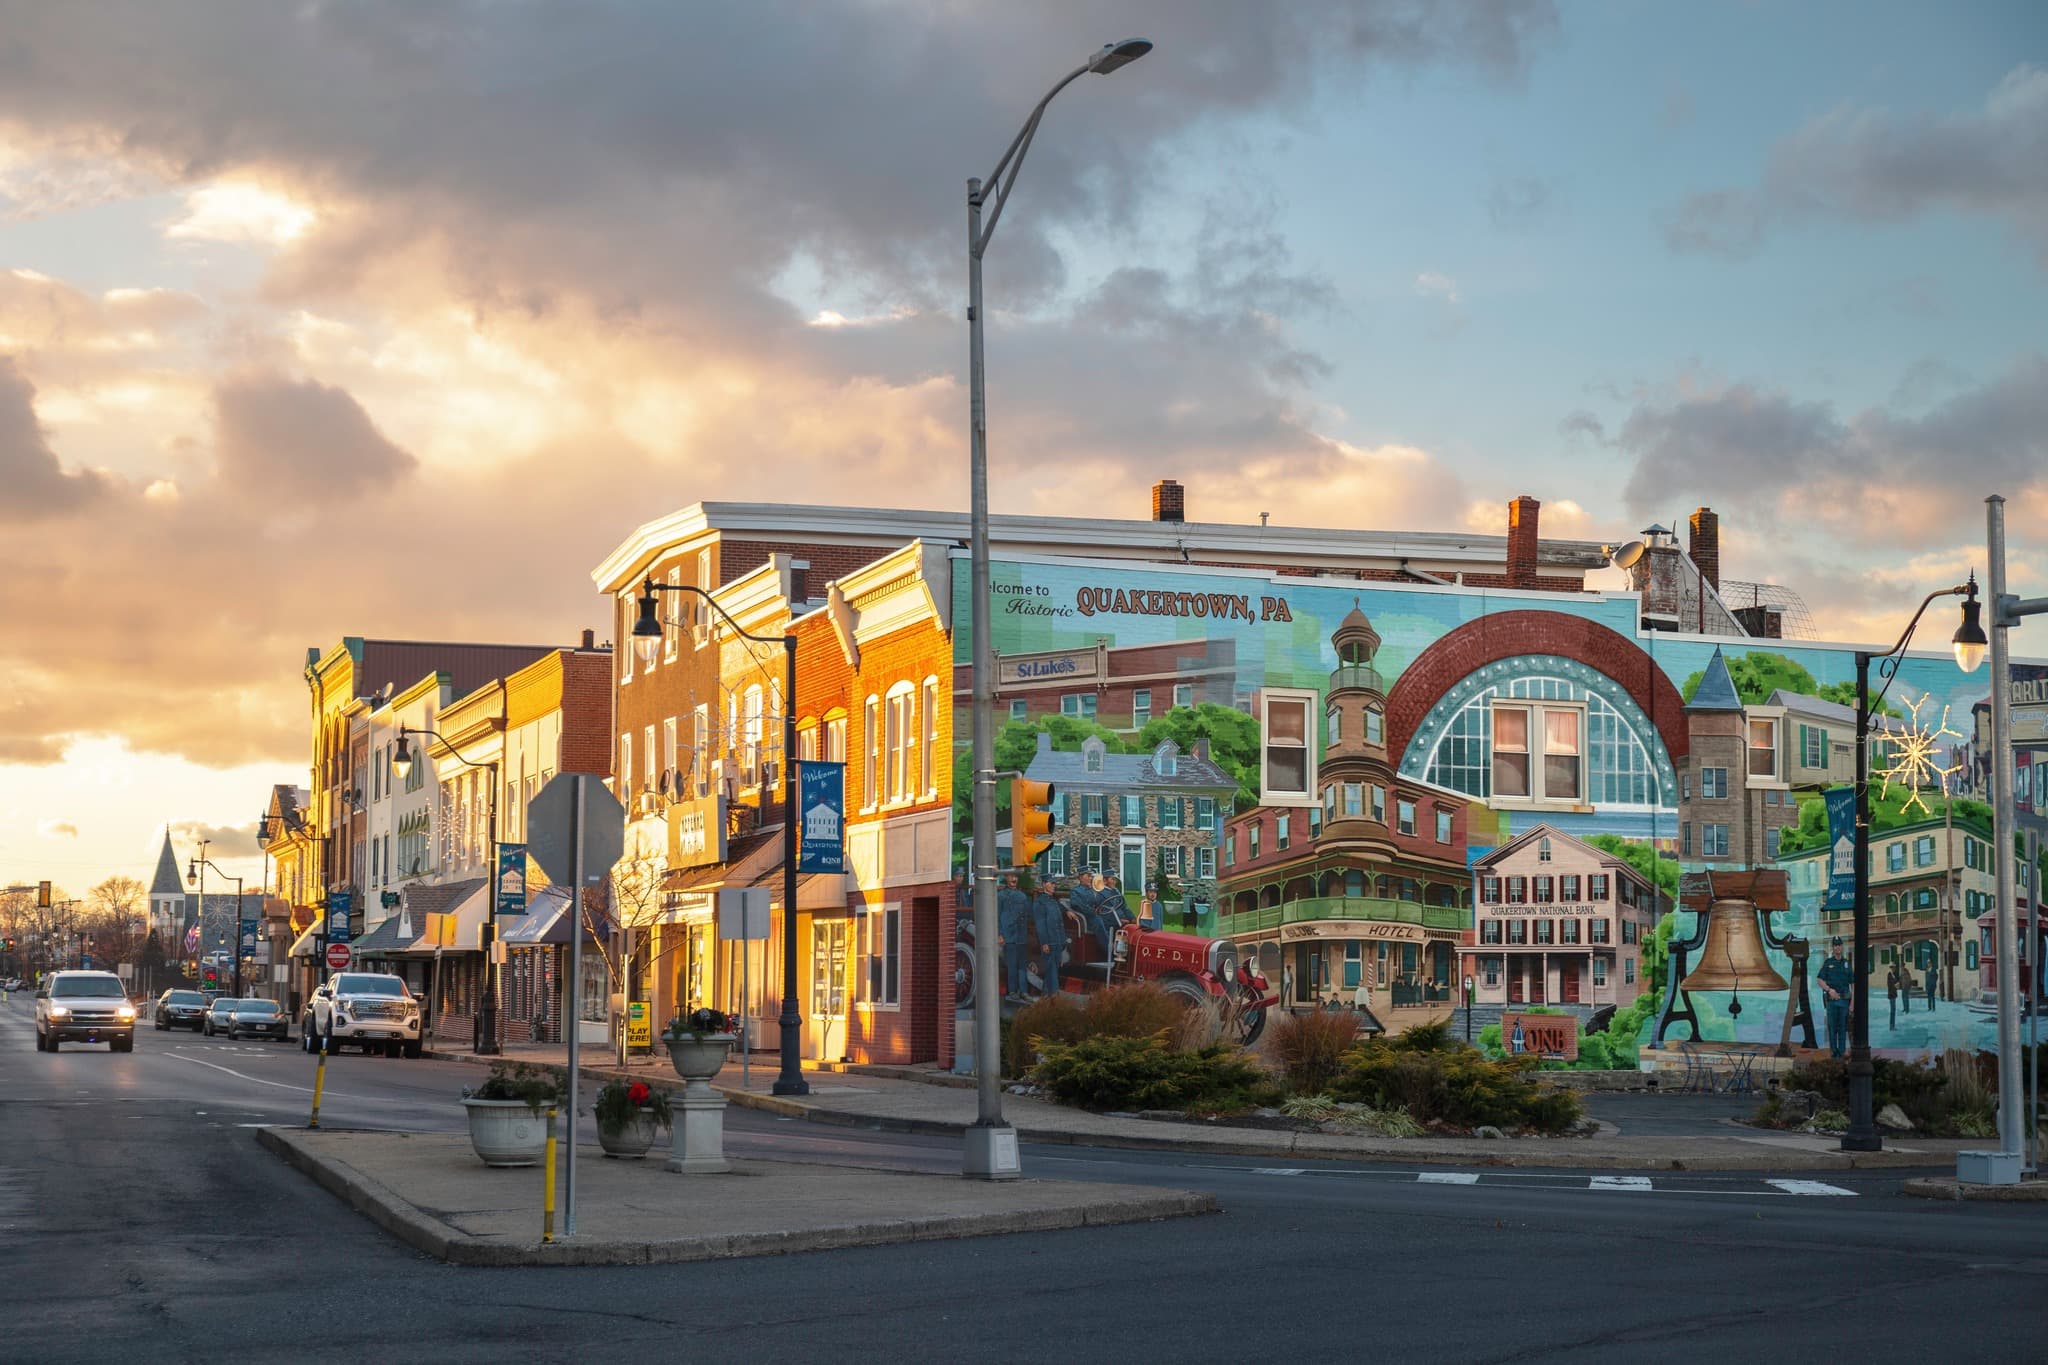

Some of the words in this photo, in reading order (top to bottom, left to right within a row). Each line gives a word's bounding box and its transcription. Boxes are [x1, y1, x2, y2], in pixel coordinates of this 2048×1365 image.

[1036, 584, 1050, 596] to
[1005, 598, 1074, 617] Historic
[1077, 586, 1256, 625] QUAKERTOWN,
[1261, 596, 1293, 622] PA
[1017, 662, 1031, 677] St
[802, 769, 838, 782] Welcome
[1490, 906, 1537, 916] QUAKERTOWN
[1539, 905, 1574, 915] NATIONAL
[1575, 905, 1596, 915] BANK
[1369, 925, 1414, 938] HOTEL
